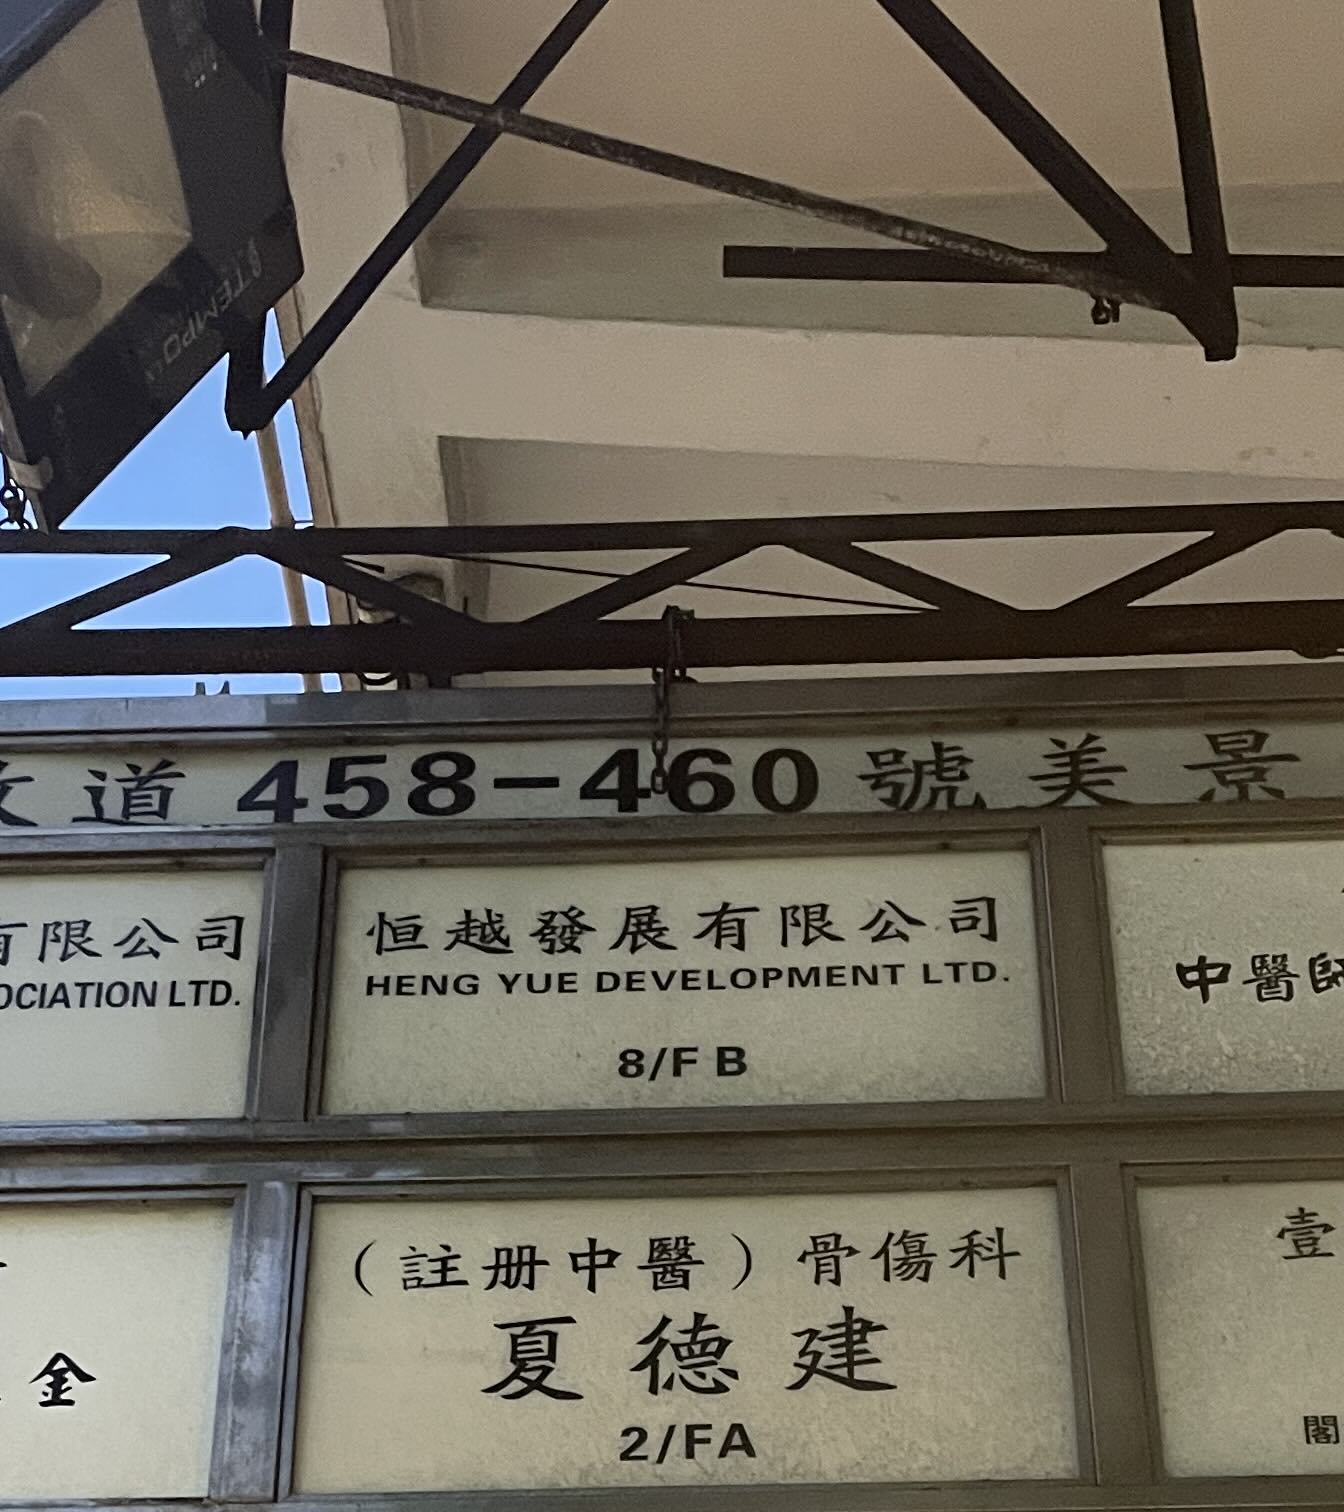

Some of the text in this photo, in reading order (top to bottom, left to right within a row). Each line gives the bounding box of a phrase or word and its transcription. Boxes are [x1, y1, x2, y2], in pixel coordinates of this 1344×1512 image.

[366, 896, 1001, 956] 恒越發展有限公司
[169, 979, 242, 1009] LTD.
[366, 961, 1011, 997] HENG YUE DEVELOPMENT LTD.
[617, 1046, 748, 1082] 8/F B
[480, 1306, 898, 1401] 夏德建
